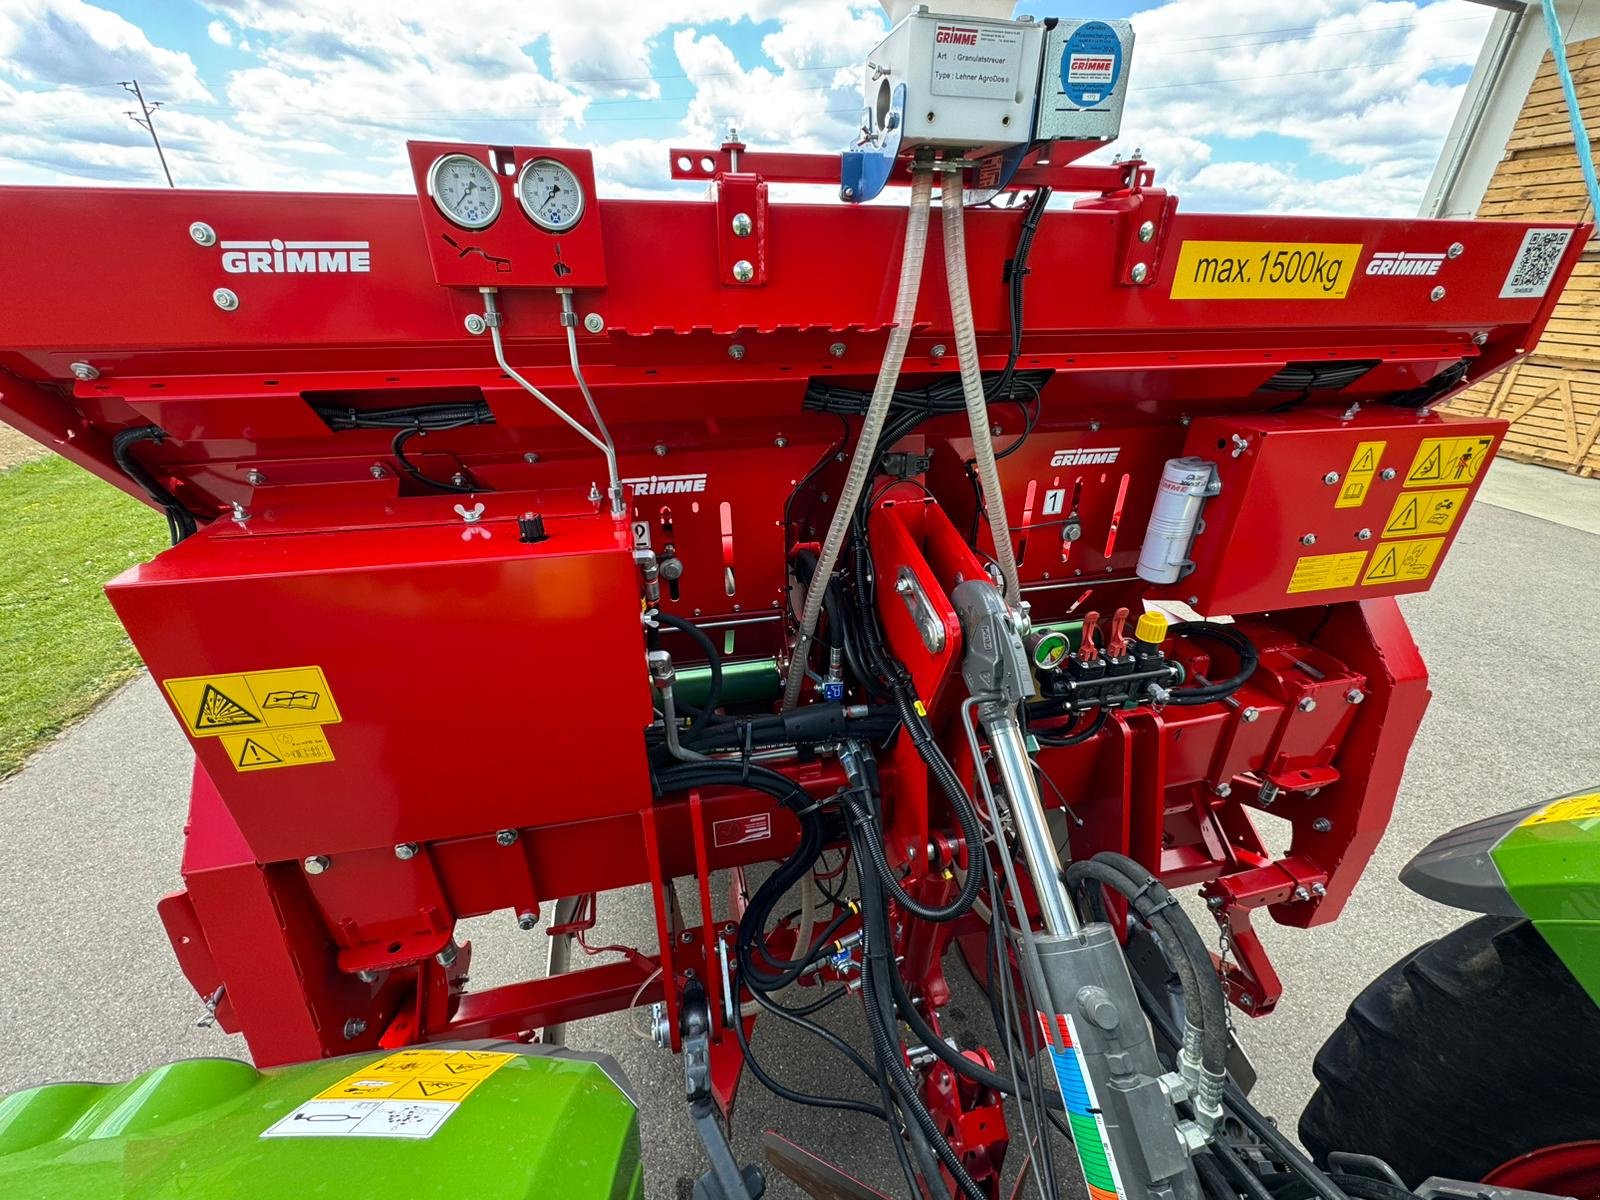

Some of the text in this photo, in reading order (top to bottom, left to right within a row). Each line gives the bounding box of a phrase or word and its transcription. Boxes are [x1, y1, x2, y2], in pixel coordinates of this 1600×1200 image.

[936, 25, 978, 46] GRIMME
[937, 52, 947, 60] Art
[957, 53, 1006, 64] Granulatstreuer
[1071, 58, 1112, 71] GRIMME
[936, 71, 950, 80] Type
[955, 72, 977, 81] Lehner
[220, 239, 371, 274] GRIMME
[1365, 251, 1446, 276] GRIMME
[1193, 250, 1343, 292] max. 1500kg
[1050, 447, 1120, 467] GRIMME
[622, 474, 707, 496] RIMME
[1049, 491, 1057, 512] 1
